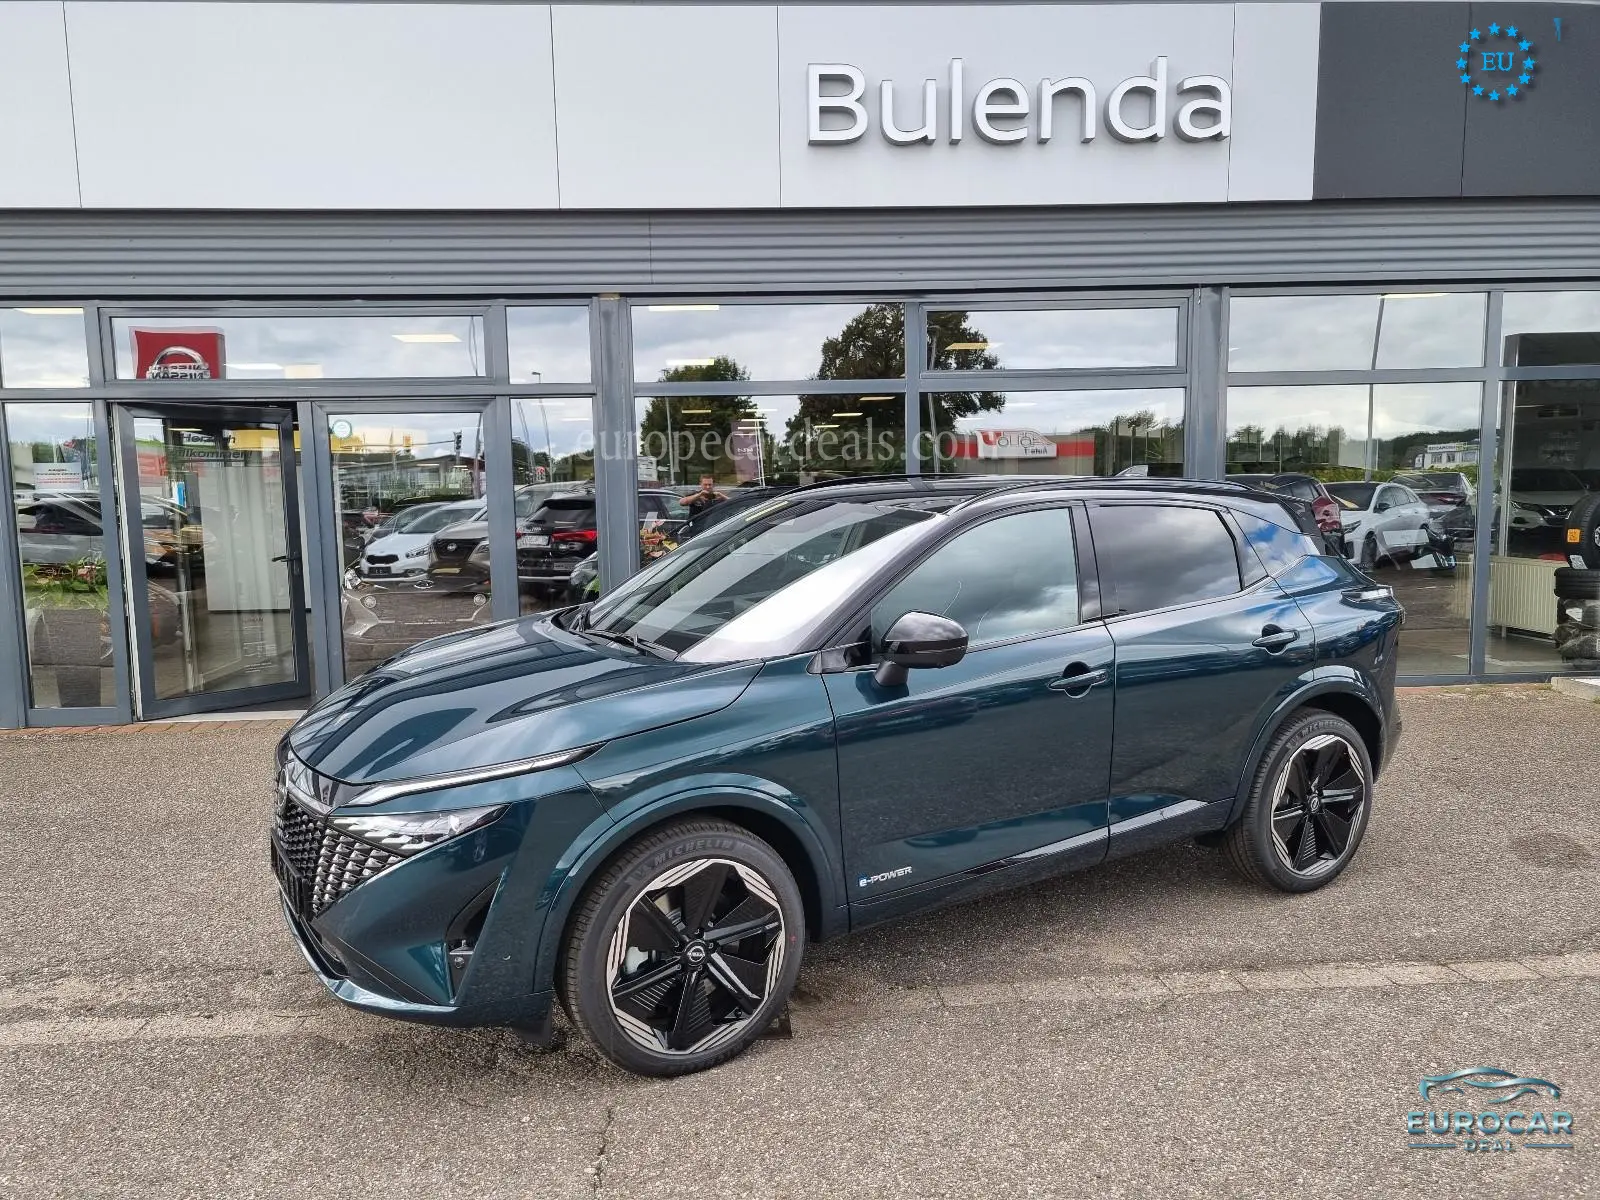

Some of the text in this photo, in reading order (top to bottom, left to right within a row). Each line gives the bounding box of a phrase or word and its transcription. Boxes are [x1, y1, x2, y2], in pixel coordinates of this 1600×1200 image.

[807, 55, 1231, 146] Bulenda
[654, 839, 735, 865] MICHELIN
[859, 866, 913, 887] e-POWER
